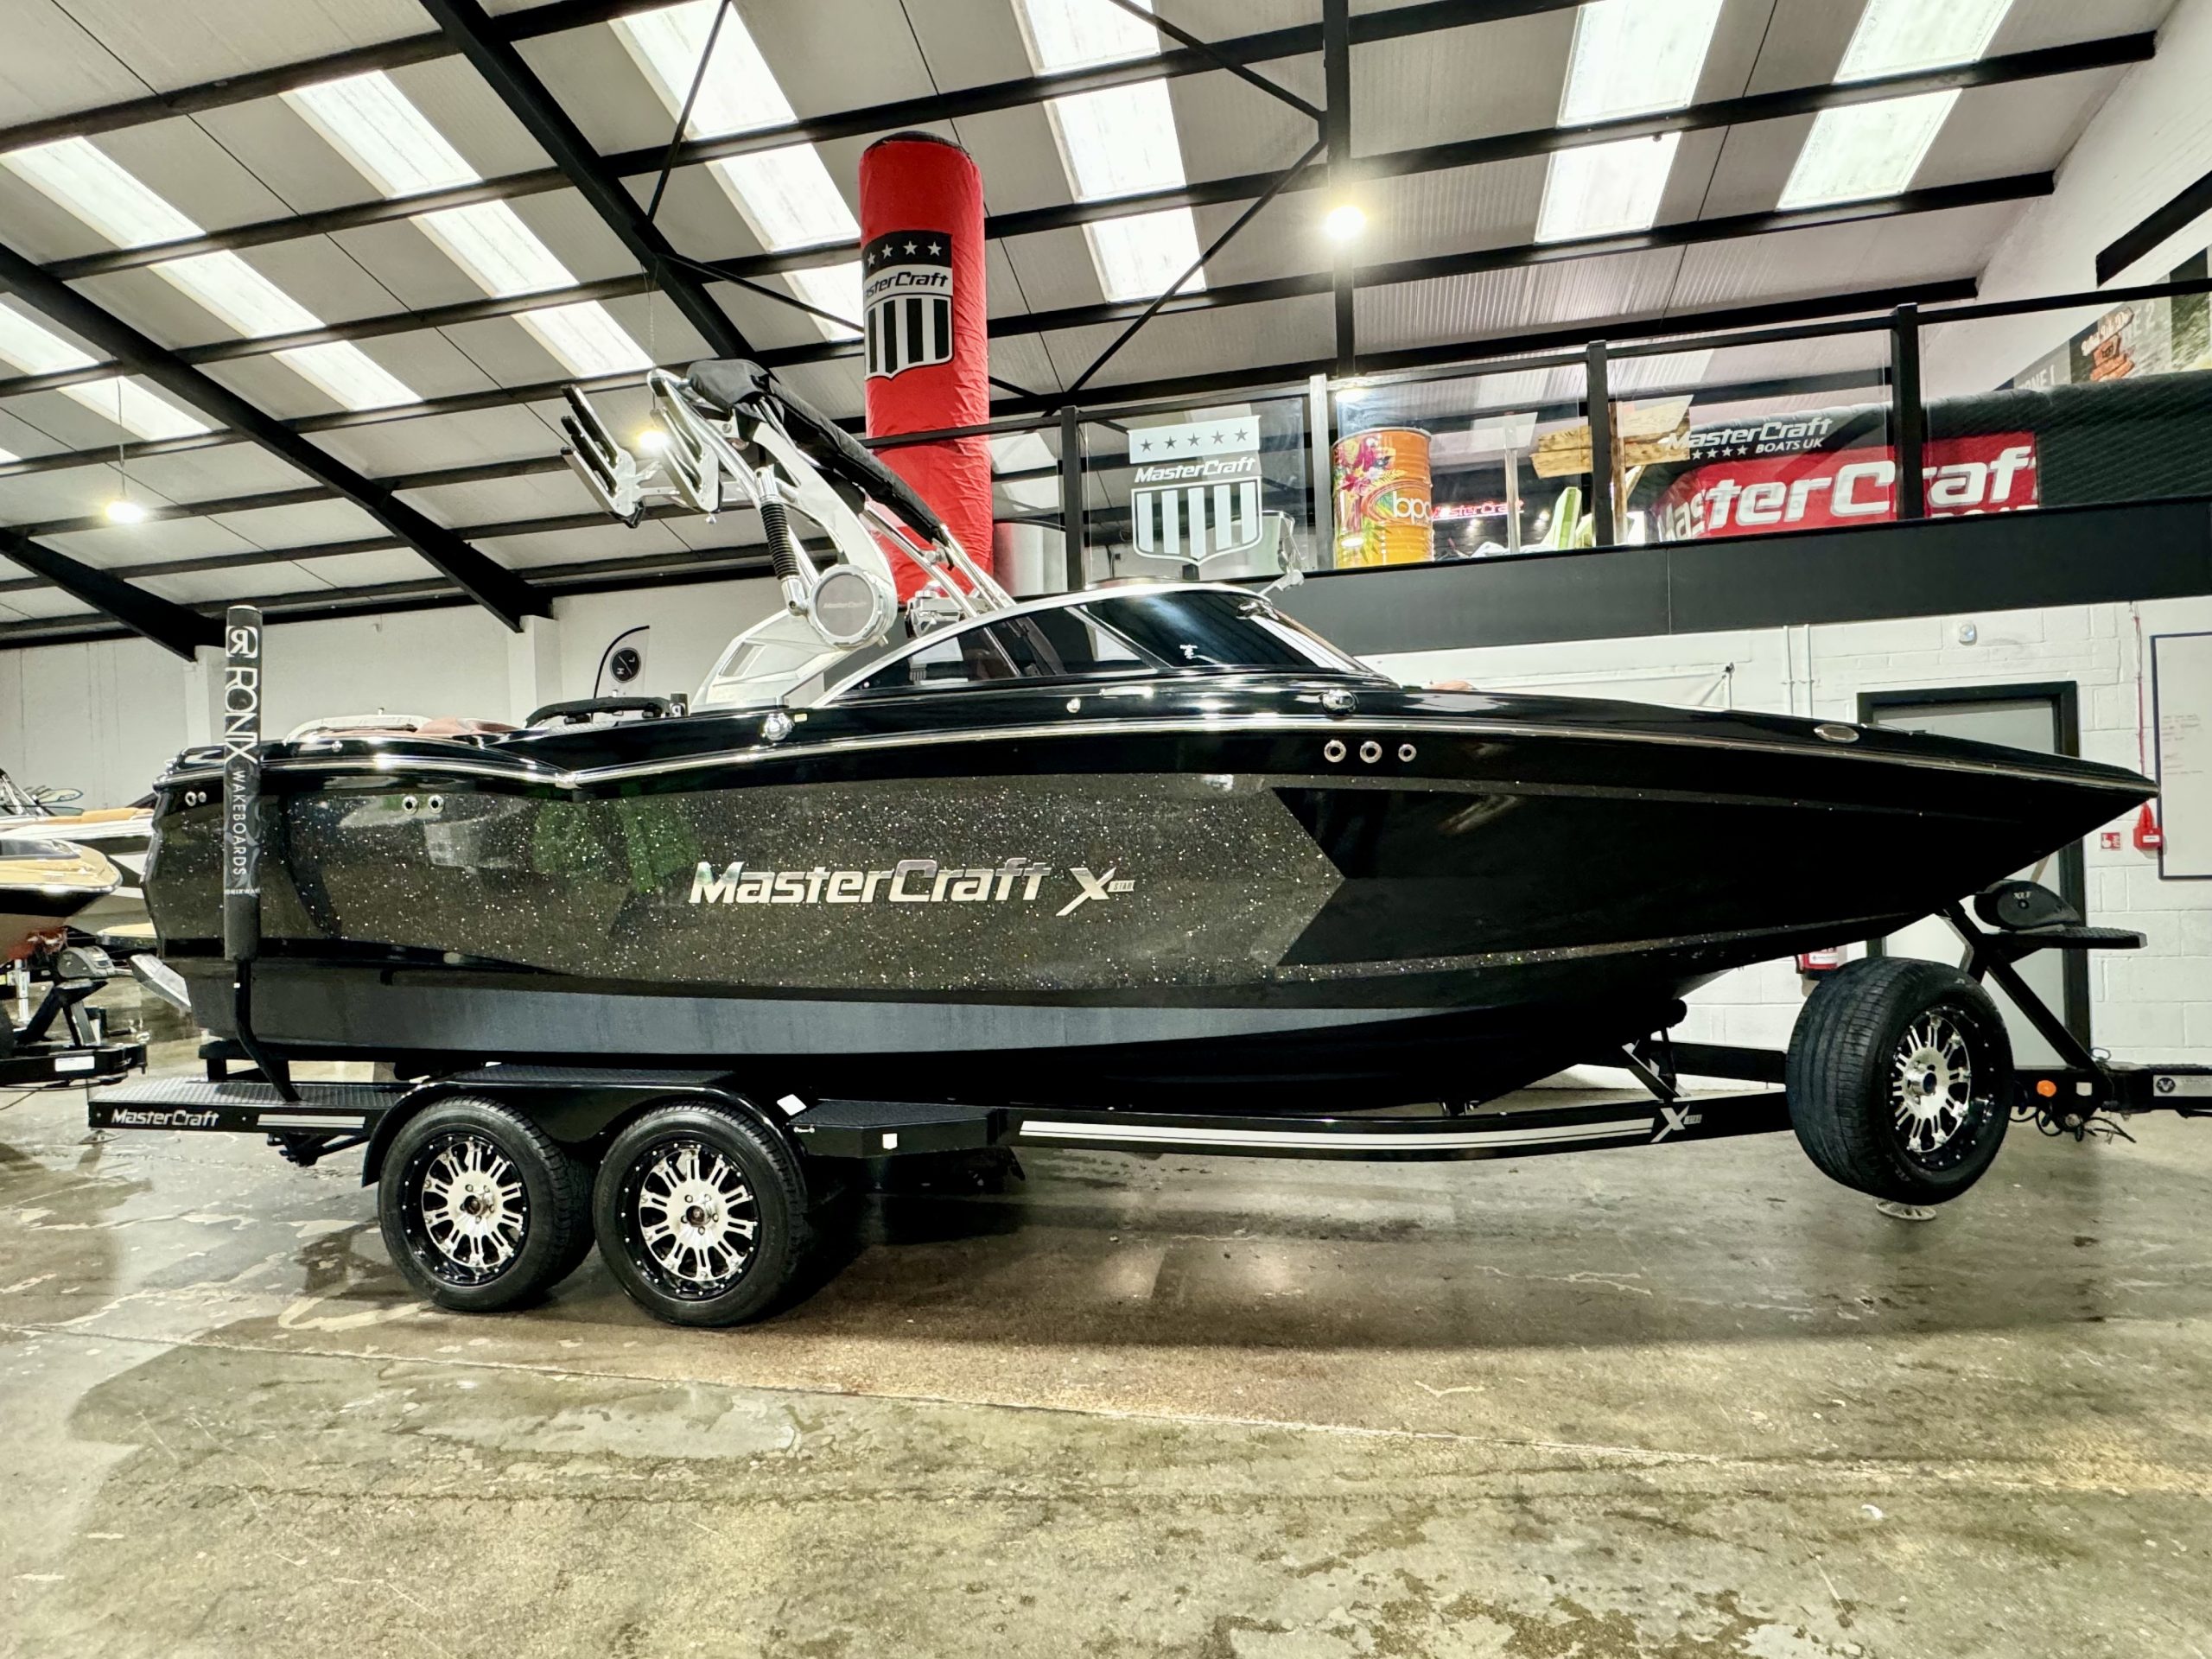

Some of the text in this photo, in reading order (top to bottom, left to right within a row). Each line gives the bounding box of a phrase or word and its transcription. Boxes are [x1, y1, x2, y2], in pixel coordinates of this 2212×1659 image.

[1663, 417, 1834, 450] MasterCraft
[1755, 437, 1823, 454] BOATS UK
[1135, 456, 1255, 483] MasterCraft
[225, 666, 258, 766] RONIX
[232, 770, 247, 875] WAKEBOARDS
[689, 858, 1052, 904] MasterCraft
[1055, 867, 1117, 917] X
[111, 1108, 219, 1127] MasterCraft
